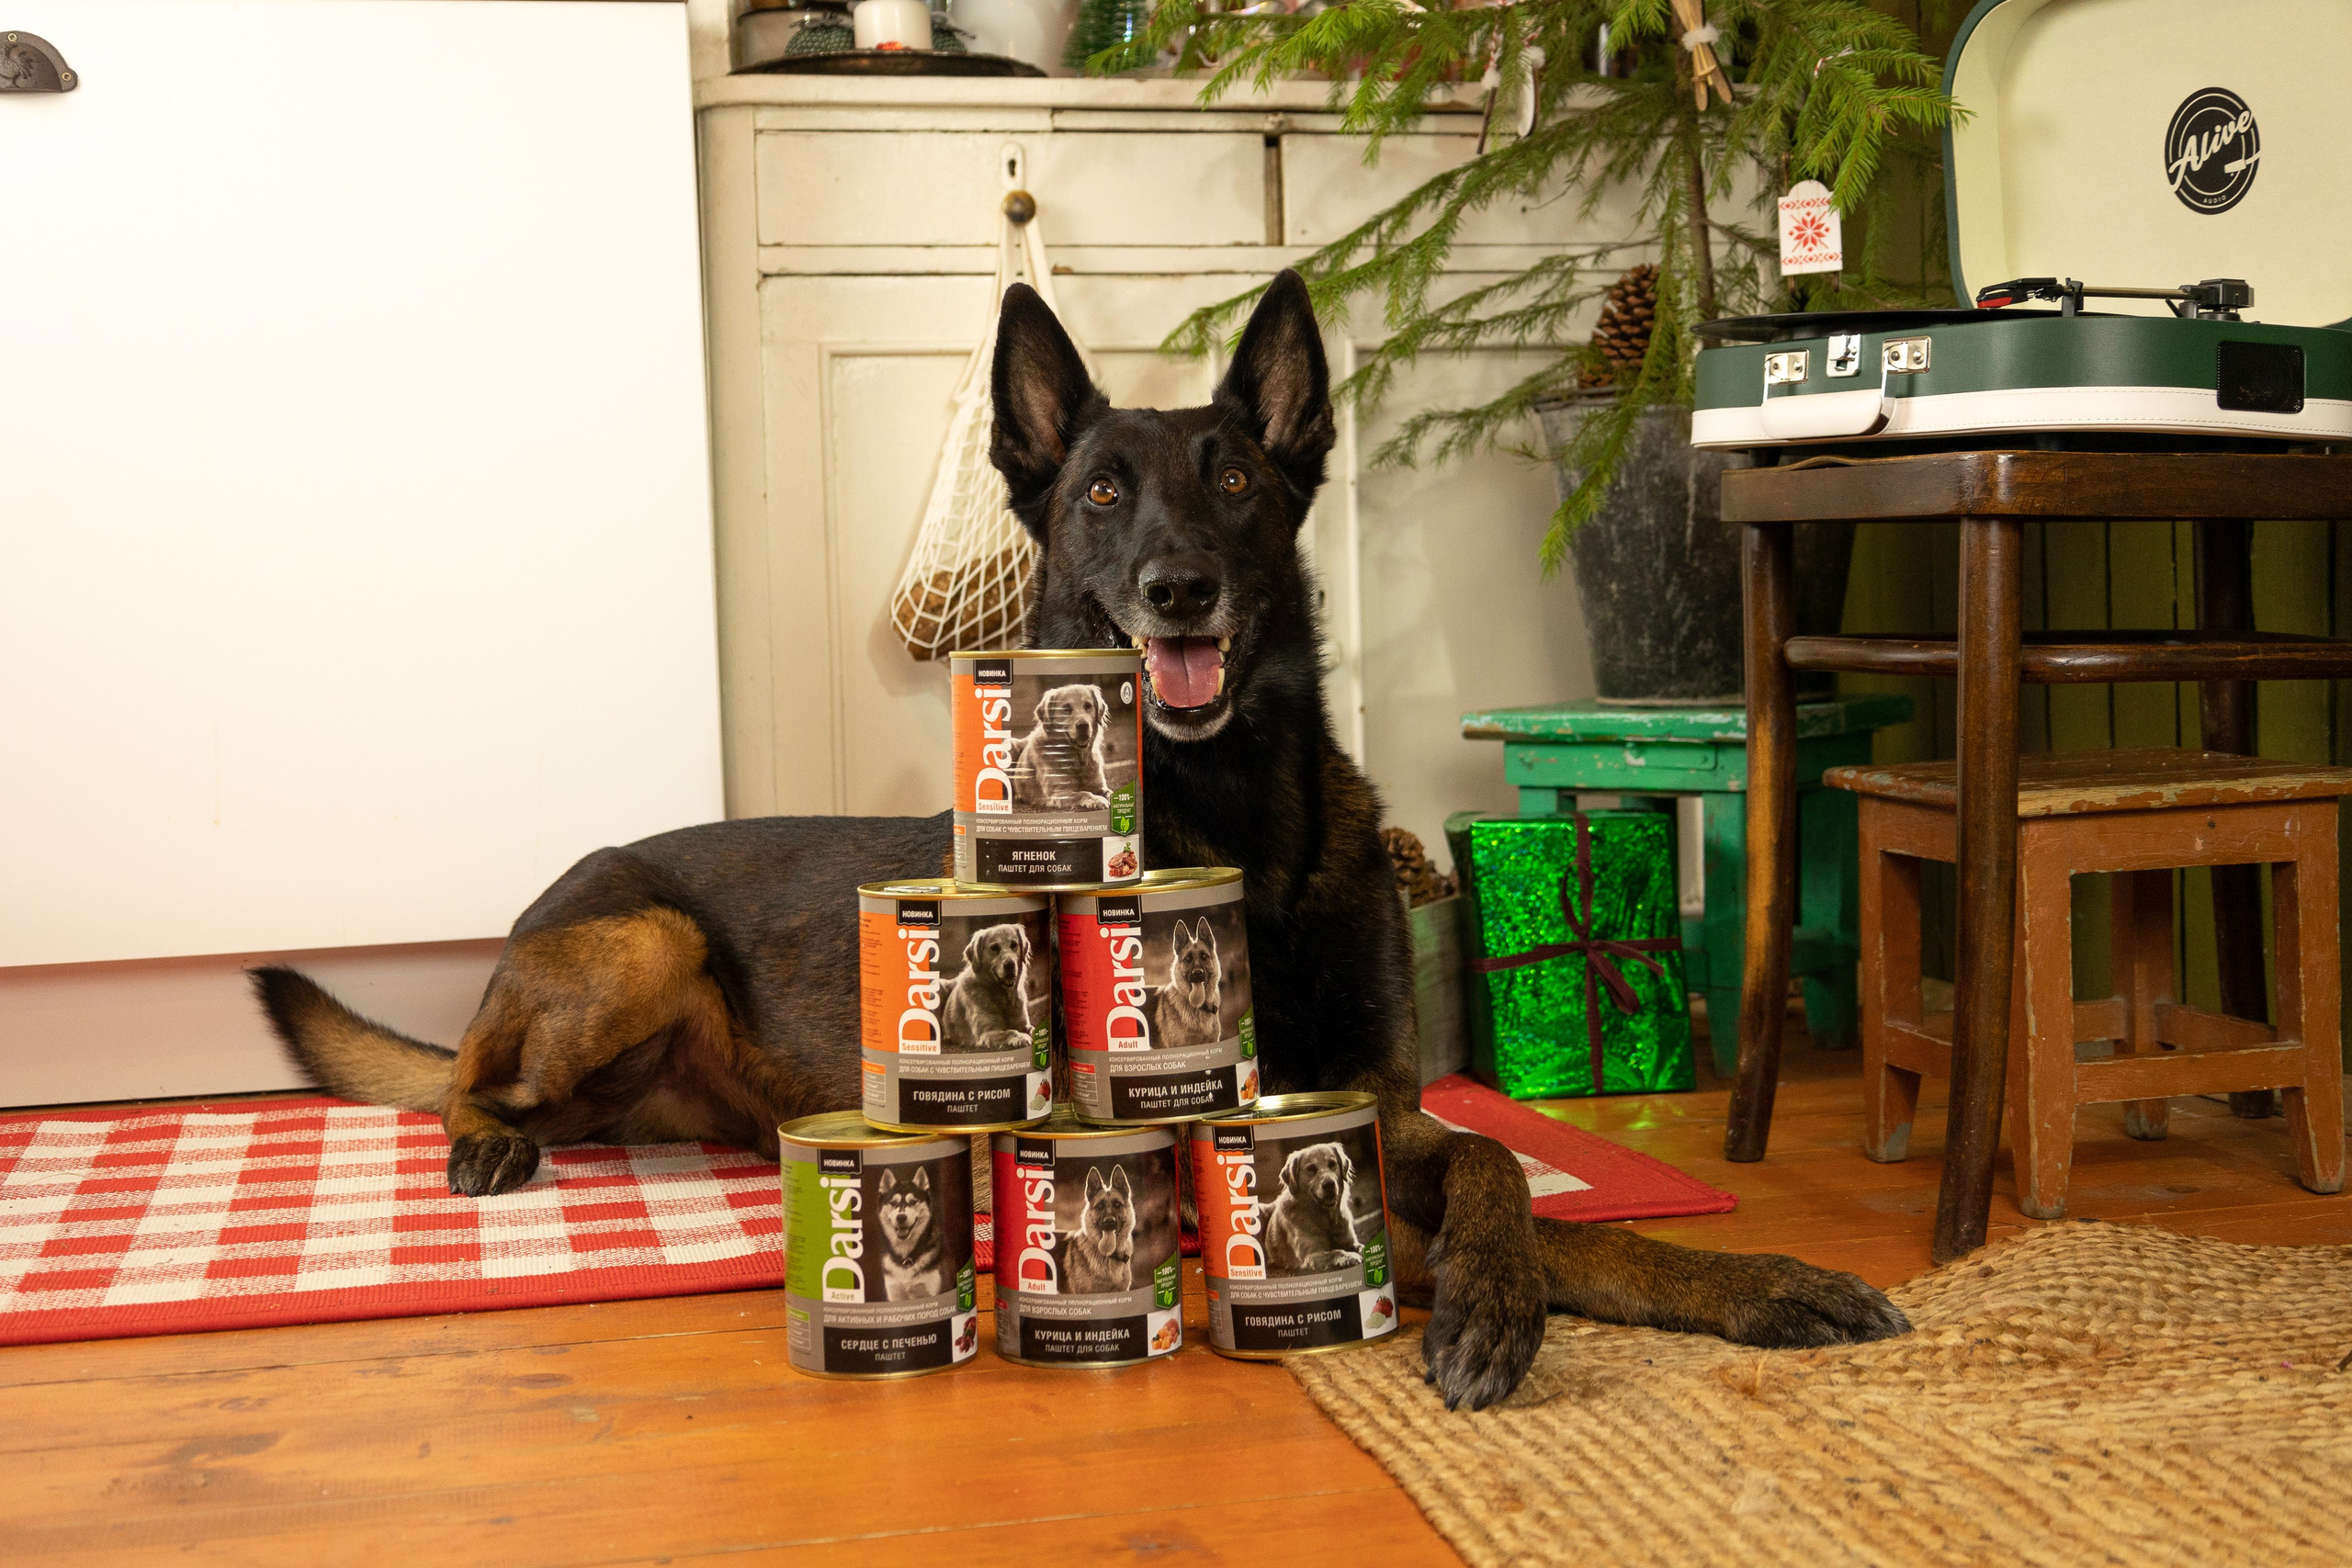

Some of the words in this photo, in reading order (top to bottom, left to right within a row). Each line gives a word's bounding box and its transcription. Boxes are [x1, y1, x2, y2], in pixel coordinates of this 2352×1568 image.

[2168, 110, 2251, 192] Alive
[2203, 195, 2226, 204] AUDIO
[975, 688, 1012, 800] Darsi
[978, 802, 1009, 811] Sensitive
[1012, 851, 1056, 861] ЯГНЕНОК
[998, 864, 1027, 873] ПАШТЕТ
[1029, 864, 1045, 874] ДЛЯ
[902, 910, 933, 919] НОВИНКА
[1102, 908, 1135, 917] НОВИНКА
[898, 928, 941, 1041] Darsi
[1100, 927, 1148, 1039] Darsi
[901, 1043, 937, 1052] Sensitive
[1118, 1040, 1138, 1048] Adult
[1128, 1086, 1168, 1098] КУРИЦА
[1170, 1086, 1178, 1095] И
[1181, 1079, 1223, 1094] ИНДЕЙКА
[913, 1090, 965, 1102] ГОВЯДИНА
[968, 1090, 975, 1100] С
[978, 1089, 1011, 1100] РИСОМ
[1140, 1099, 1171, 1109] ПАШТЕТ
[1173, 1098, 1189, 1108] ДЛЯ
[1191, 1095, 1214, 1105] СОБАК
[947, 1104, 978, 1113] ПАШТЕТ
[1218, 1135, 1247, 1144] НОВИНКА
[1020, 1150, 1048, 1159] НОВИНКА
[823, 1158, 854, 1168] НОВИНКА
[1216, 1154, 1265, 1266] Darsi
[1016, 1168, 1057, 1280] Darsi
[820, 1177, 865, 1290] Darsi
[1230, 1268, 1262, 1278] Sensitive
[1028, 1282, 1046, 1292] Adult
[831, 1292, 854, 1300] Active
[1245, 1315, 1295, 1327] ГОВЯДИНА
[1297, 1314, 1304, 1325] С
[1306, 1309, 1341, 1323] РИСОМ
[1035, 1330, 1072, 1342] КУРИЦА
[1075, 1331, 1082, 1341] И
[1084, 1328, 1130, 1342] ИНДЕЙКА
[1278, 1327, 1308, 1337] ПАШТЕТ
[841, 1339, 879, 1351] СЕРДЦЕ
[882, 1339, 888, 1349] С
[892, 1333, 937, 1348] ПЕЧЕНЬЮ
[1045, 1344, 1075, 1353] ПАШТЕТ
[1077, 1345, 1092, 1354] ДЛЯ
[1094, 1343, 1119, 1353] СОБАК
[875, 1351, 906, 1361] ПАШТЕТ
